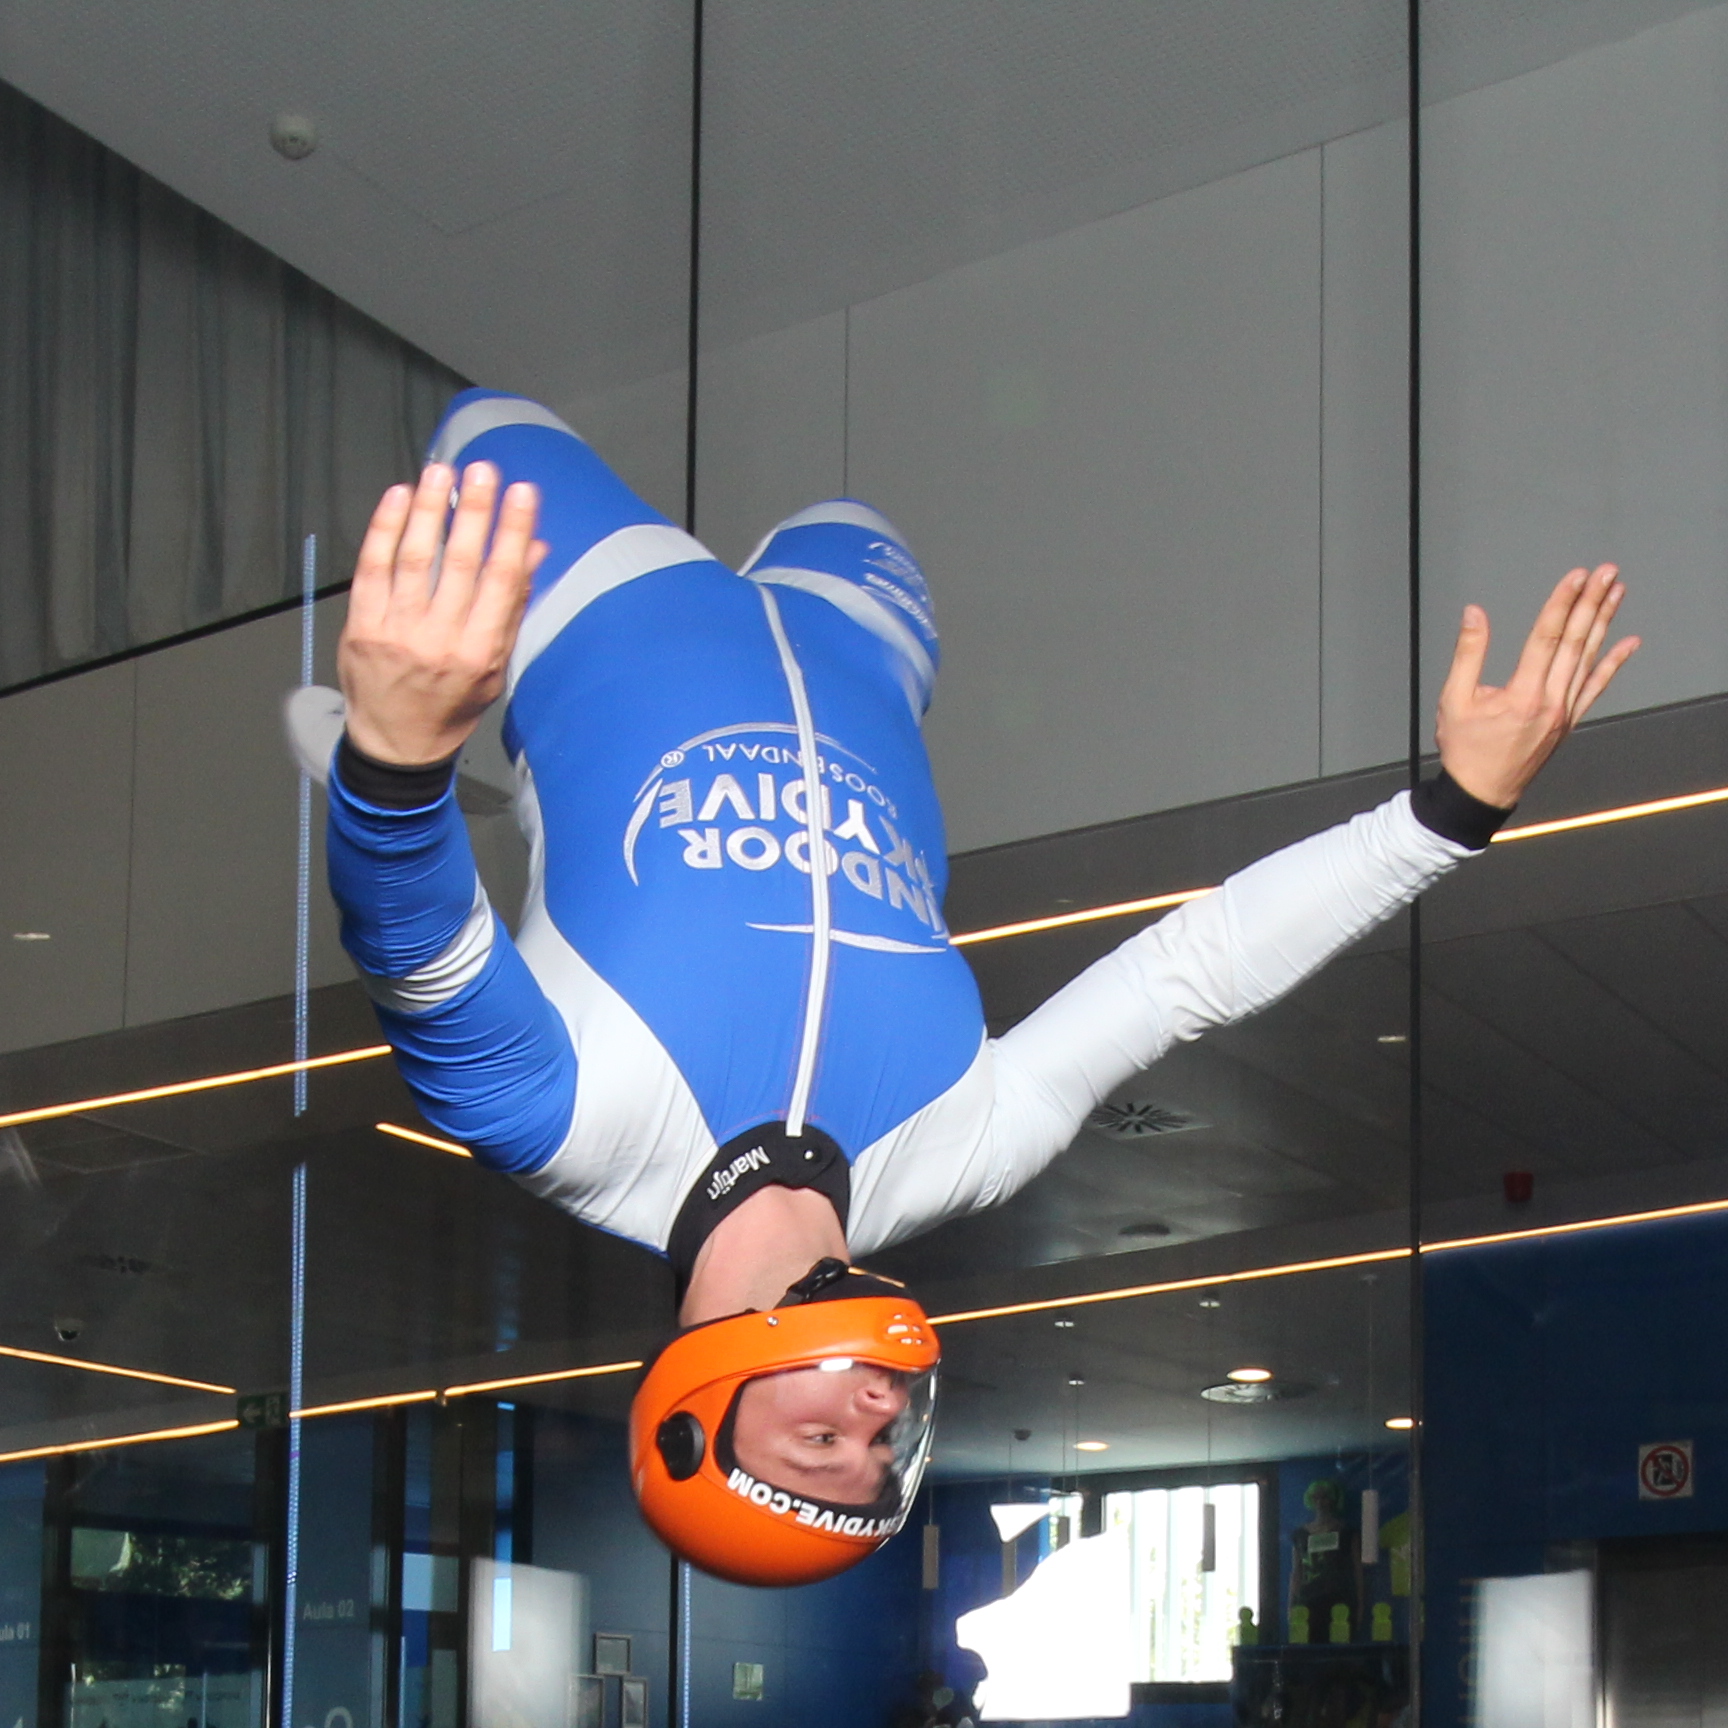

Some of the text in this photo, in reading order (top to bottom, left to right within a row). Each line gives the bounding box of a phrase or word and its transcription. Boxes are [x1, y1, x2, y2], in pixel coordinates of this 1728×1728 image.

[677, 825, 944, 933] INDOOR
[706, 1145, 771, 1201] Martijn
[303, 1599, 355, 1621] Aula 02
[17, 1621, 31, 1640] 01
